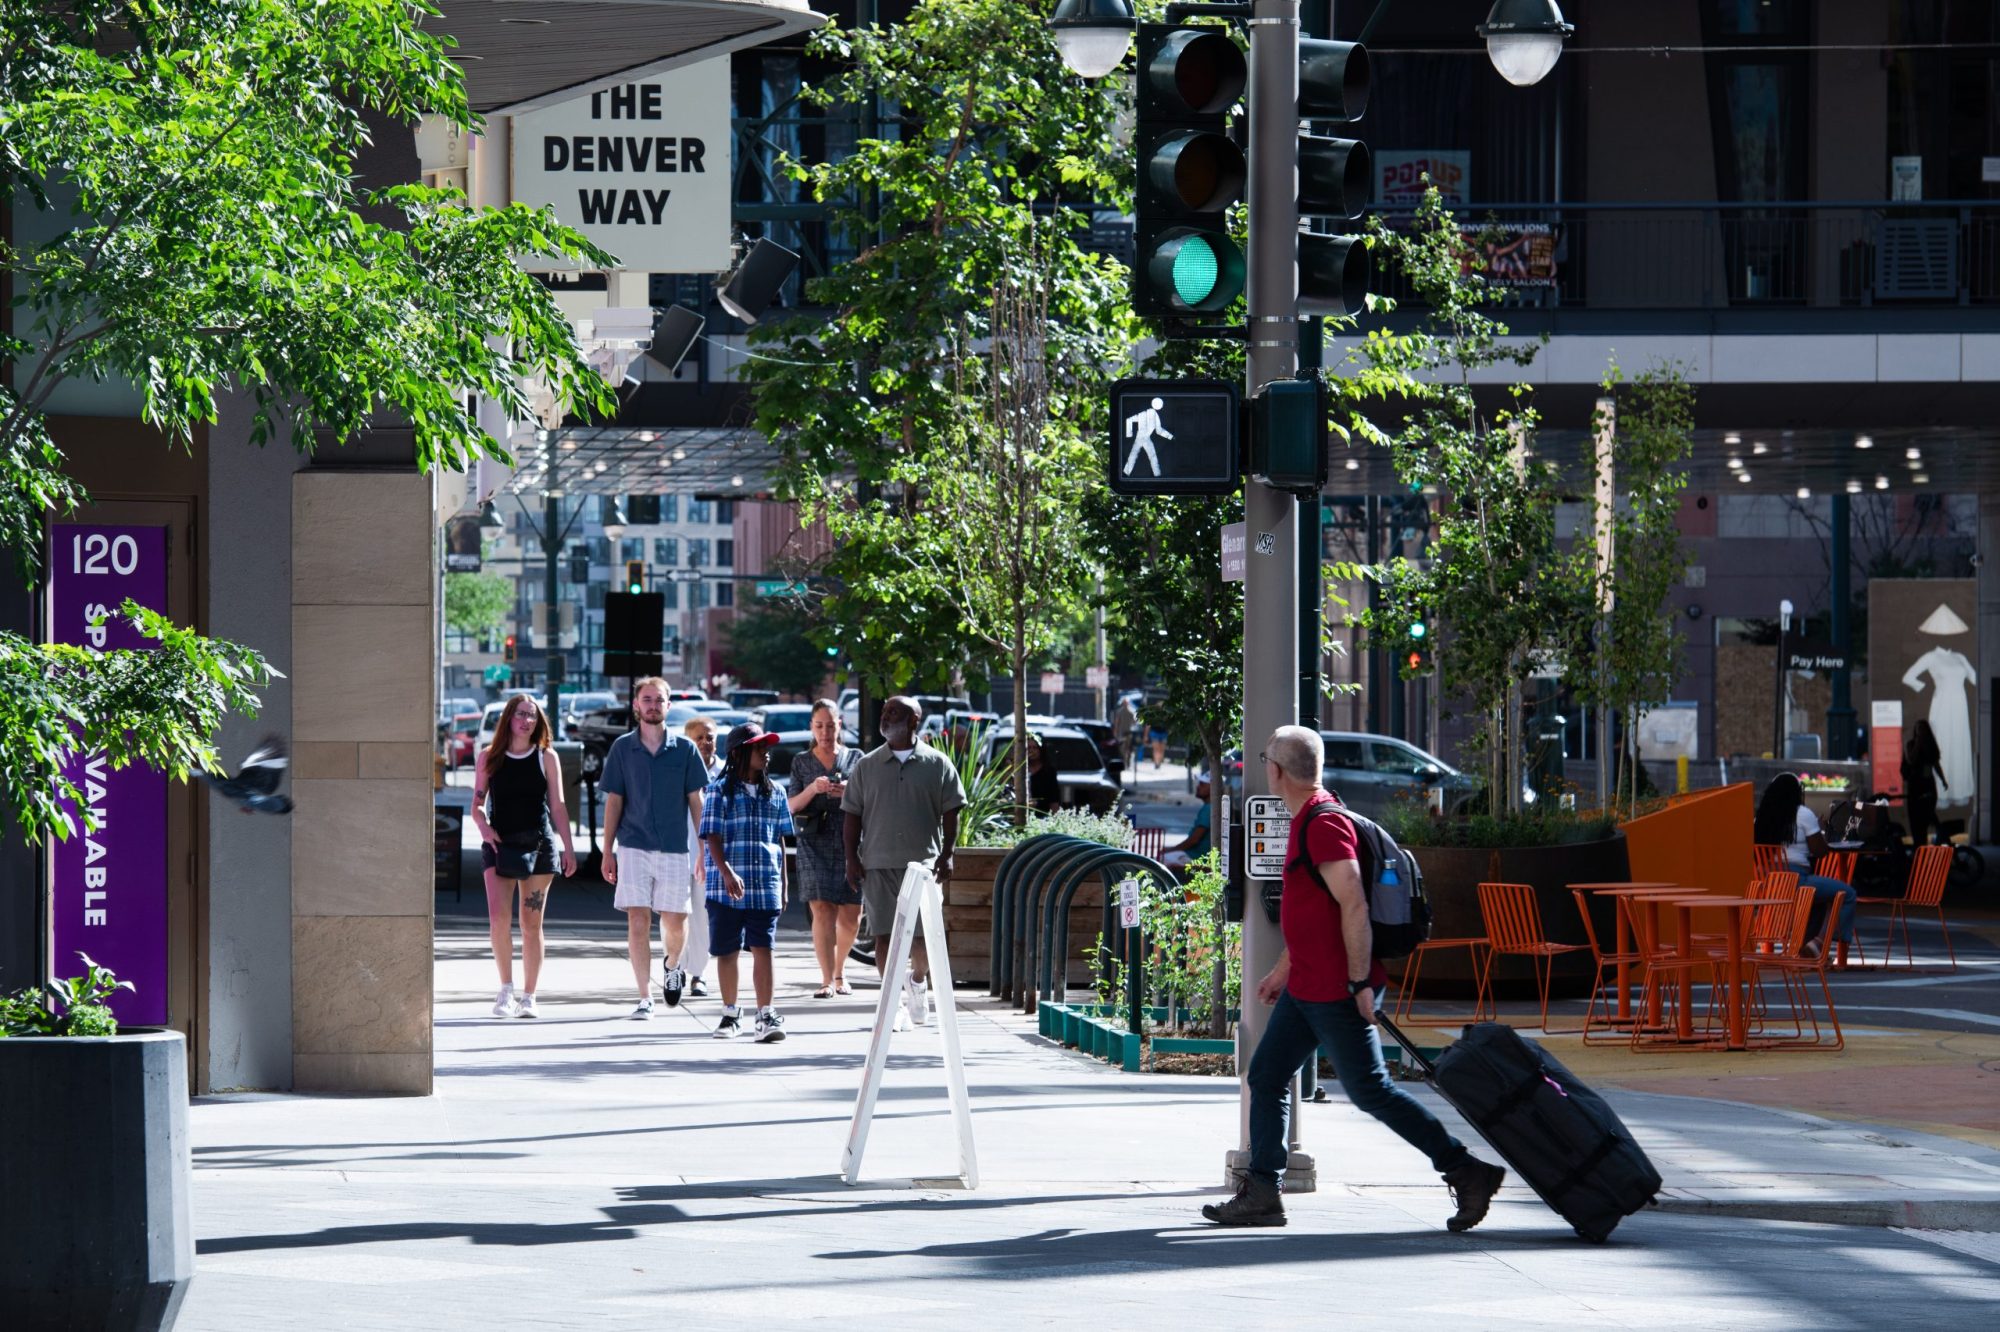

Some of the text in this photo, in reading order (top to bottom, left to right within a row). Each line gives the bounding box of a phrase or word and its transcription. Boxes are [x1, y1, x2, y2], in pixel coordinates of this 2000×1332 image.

[591, 83, 662, 119] THE
[543, 135, 706, 173] DENVER
[1383, 159, 1462, 189] POP UP
[578, 188, 672, 225] WAY
[1513, 279, 1550, 287] SALOON
[73, 533, 139, 576] 120
[1791, 655, 1844, 670] Pay Here
